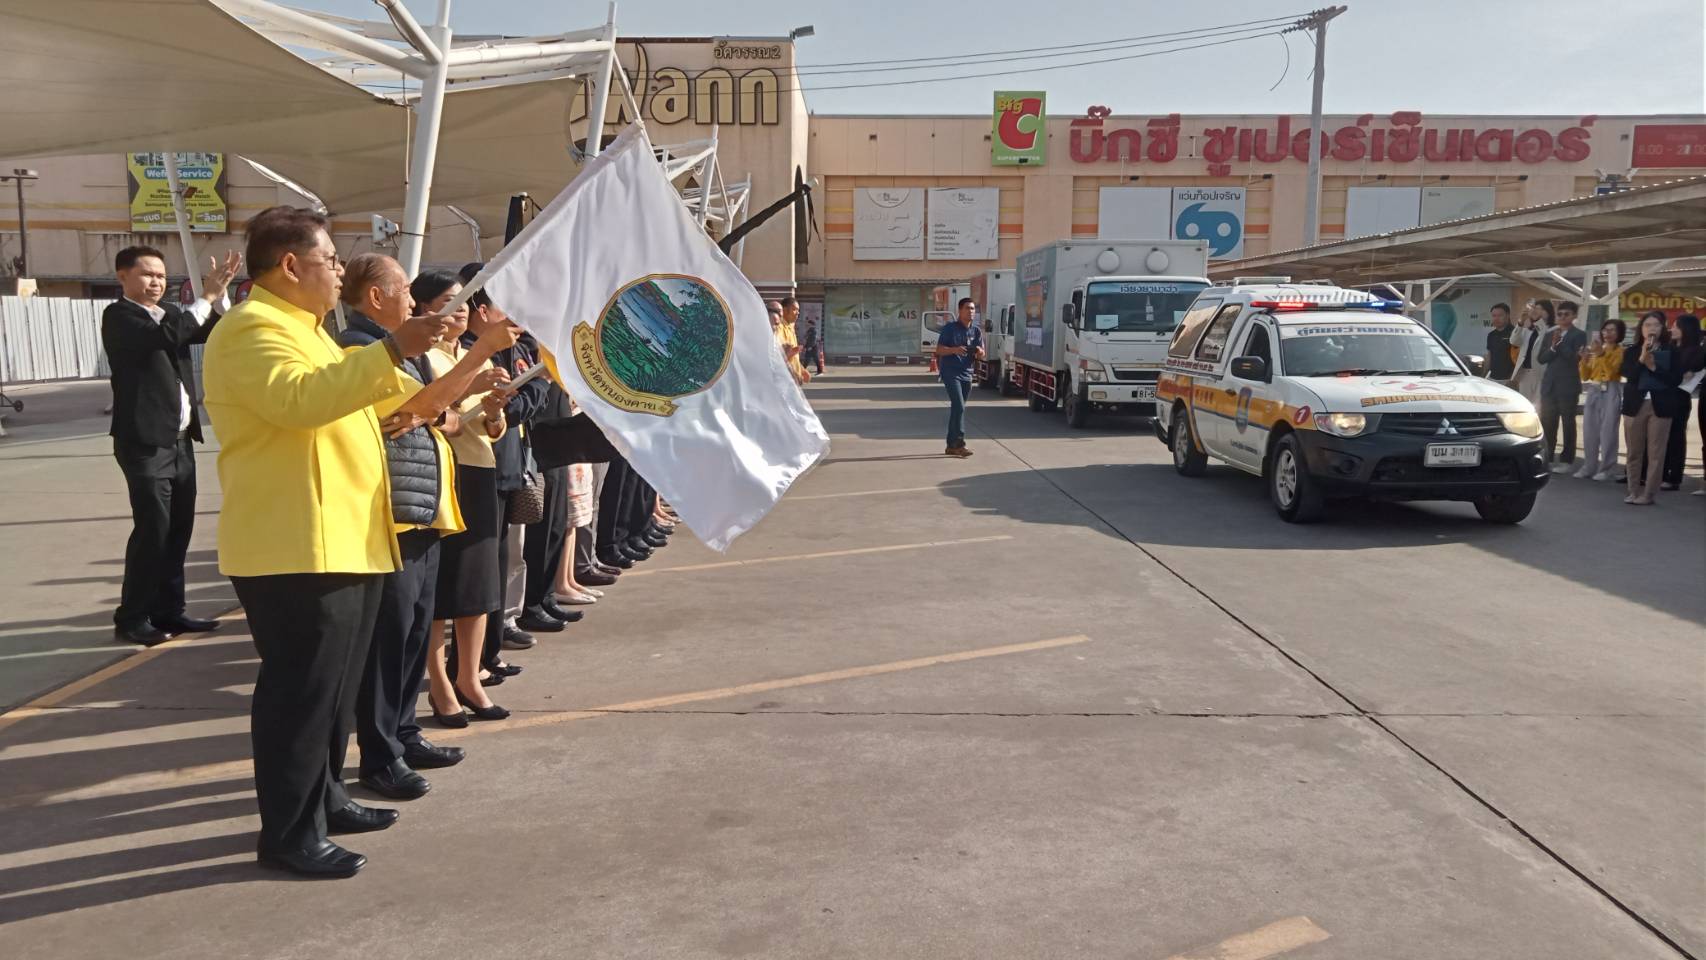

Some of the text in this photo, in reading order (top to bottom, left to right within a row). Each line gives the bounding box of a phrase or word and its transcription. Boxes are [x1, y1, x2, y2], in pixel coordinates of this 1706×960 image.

[998, 97, 1042, 151] C
[1070, 105, 1181, 164] บิ๊กซี
[177, 168, 213, 178] Service
[1178, 189, 1241, 201] แว่นท็อปเจริญ
[850, 310, 871, 320] AIS
[898, 310, 917, 320] AIS
[580, 342, 656, 410] จังหวัดหนองคาย
